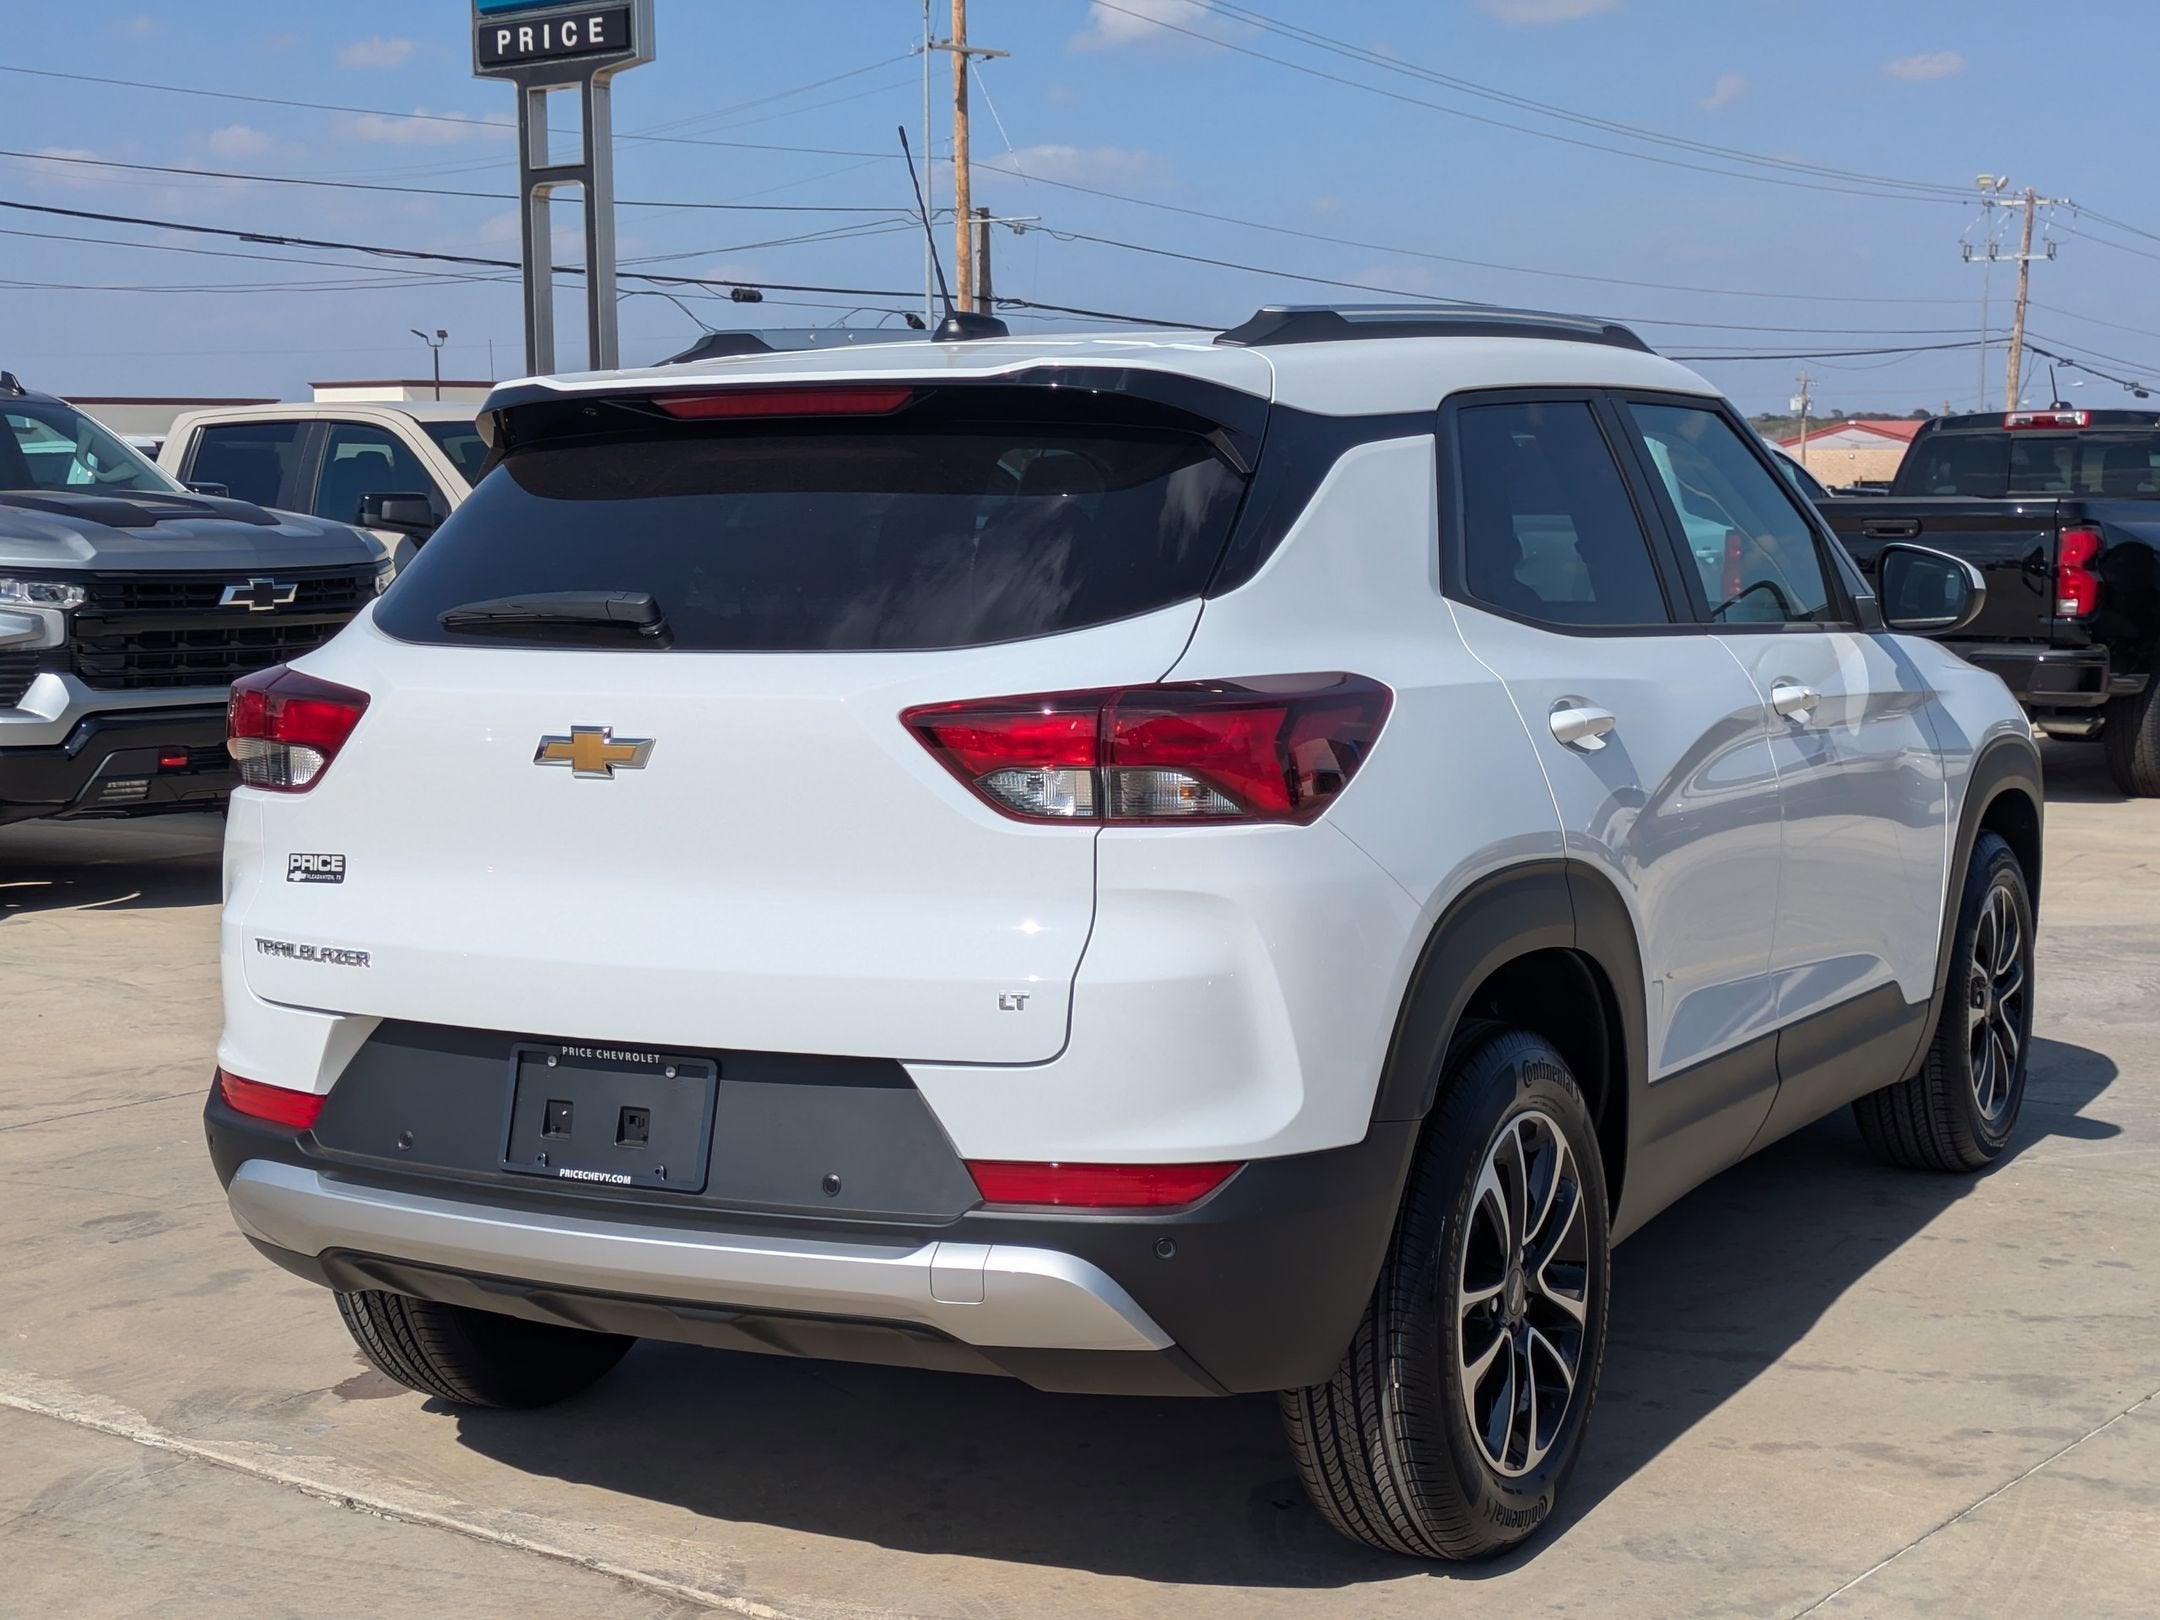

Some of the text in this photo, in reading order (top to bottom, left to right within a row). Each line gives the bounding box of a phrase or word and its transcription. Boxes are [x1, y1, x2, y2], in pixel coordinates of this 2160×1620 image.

[497, 17, 604, 55] PRICE
[290, 855, 343, 872] PRICE
[255, 937, 370, 968] TRAILBLAZER
[999, 991, 1030, 1011] LT
[562, 1046, 660, 1063] PRICE CHEVROLET
[1522, 1057, 1576, 1098] Continental
[559, 1168, 631, 1185] PRICECHEVY.COM
[1490, 1496, 1548, 1532] Continental
